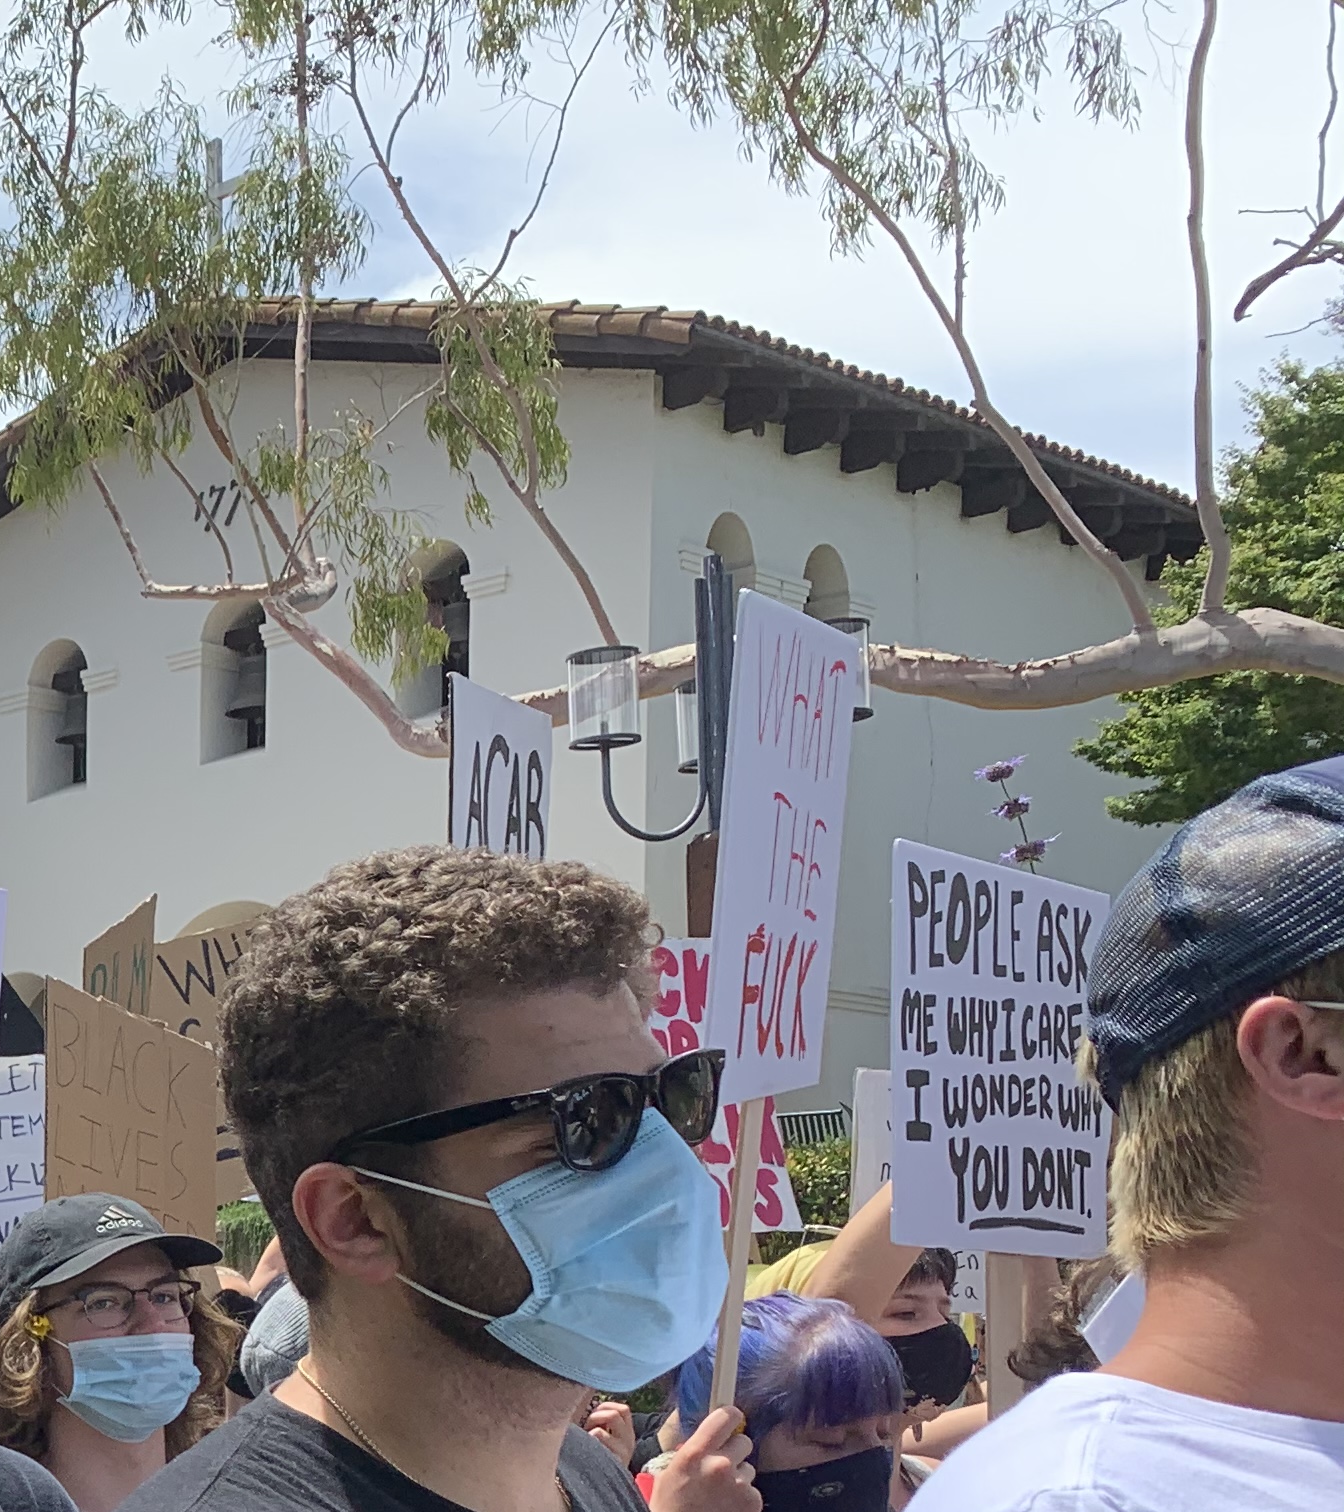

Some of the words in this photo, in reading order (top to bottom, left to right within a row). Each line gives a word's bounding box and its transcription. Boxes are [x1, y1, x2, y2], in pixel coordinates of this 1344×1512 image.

[759, 617, 847, 783] WHAT
[768, 791, 827, 921] THE
[907, 861, 1025, 983] PEOPLE
[1037, 899, 1092, 993] ASK
[737, 924, 818, 1061] FUCK
[900, 987, 937, 1057] ME
[946, 997, 998, 1065] WHY
[999, 998, 1016, 1062] I
[1021, 1002, 1083, 1066] CARE
[53, 1002, 190, 1130] BLACK
[905, 1068, 932, 1142] I
[942, 1073, 1053, 1129] WONDER
[1058, 1083, 1103, 1138] WHY
[53, 1104, 188, 1201] LIVES
[948, 1137, 1010, 1223] YOU
